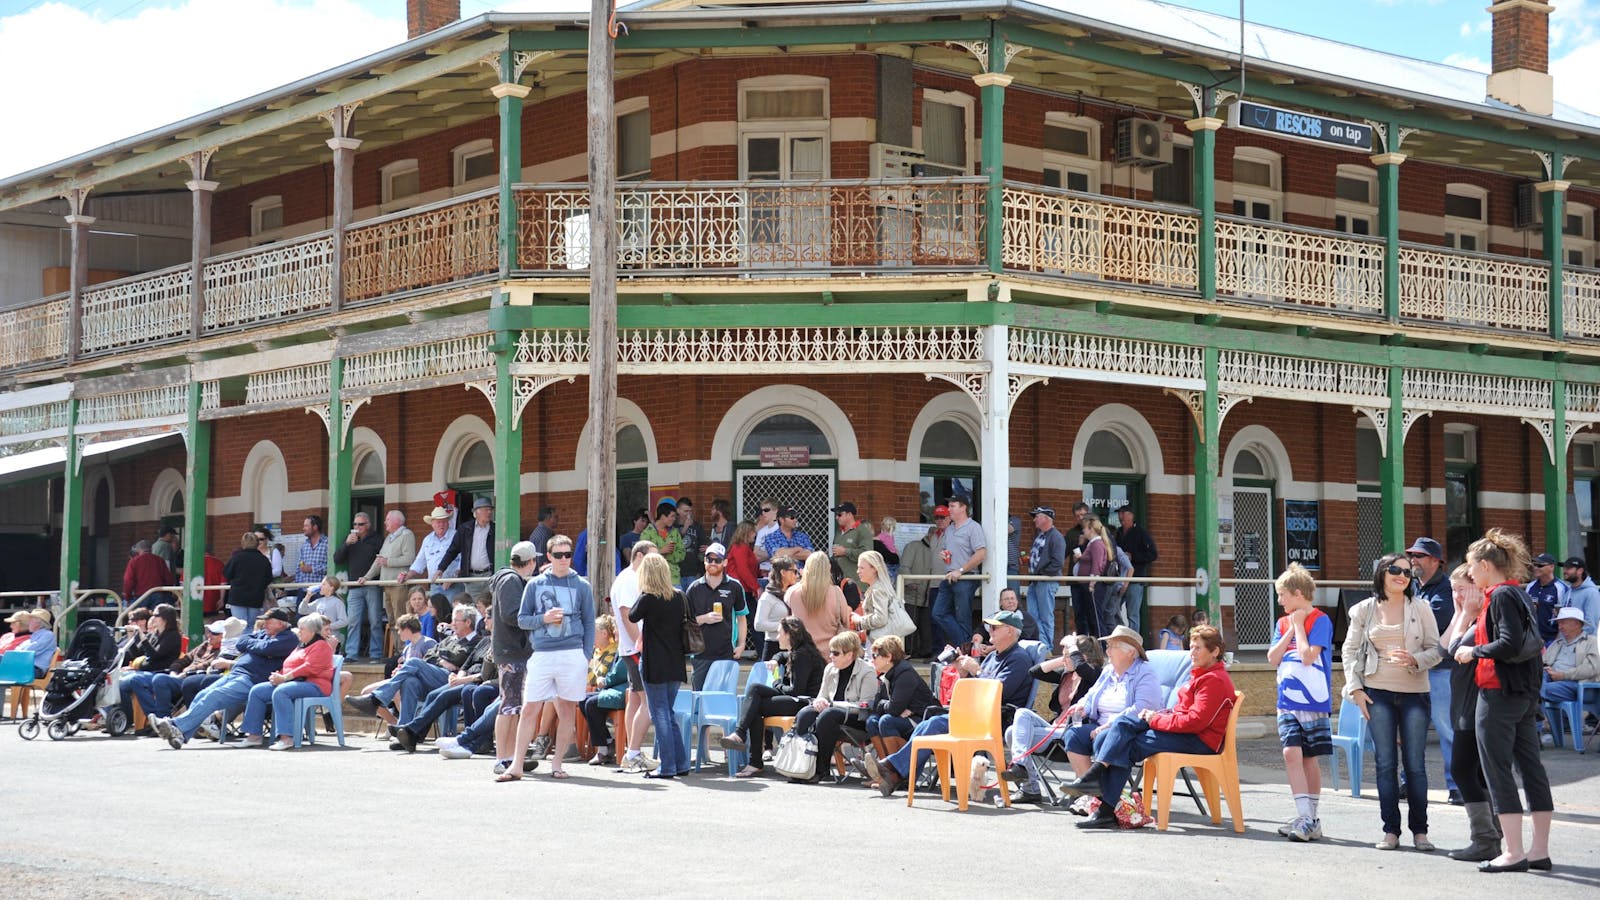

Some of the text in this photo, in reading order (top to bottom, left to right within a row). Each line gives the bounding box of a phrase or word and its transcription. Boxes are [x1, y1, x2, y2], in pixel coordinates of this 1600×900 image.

[1275, 111, 1362, 144] RESCHS on tap
[1286, 517, 1318, 531] RESCHS
[1288, 548, 1318, 560] ON TAP
